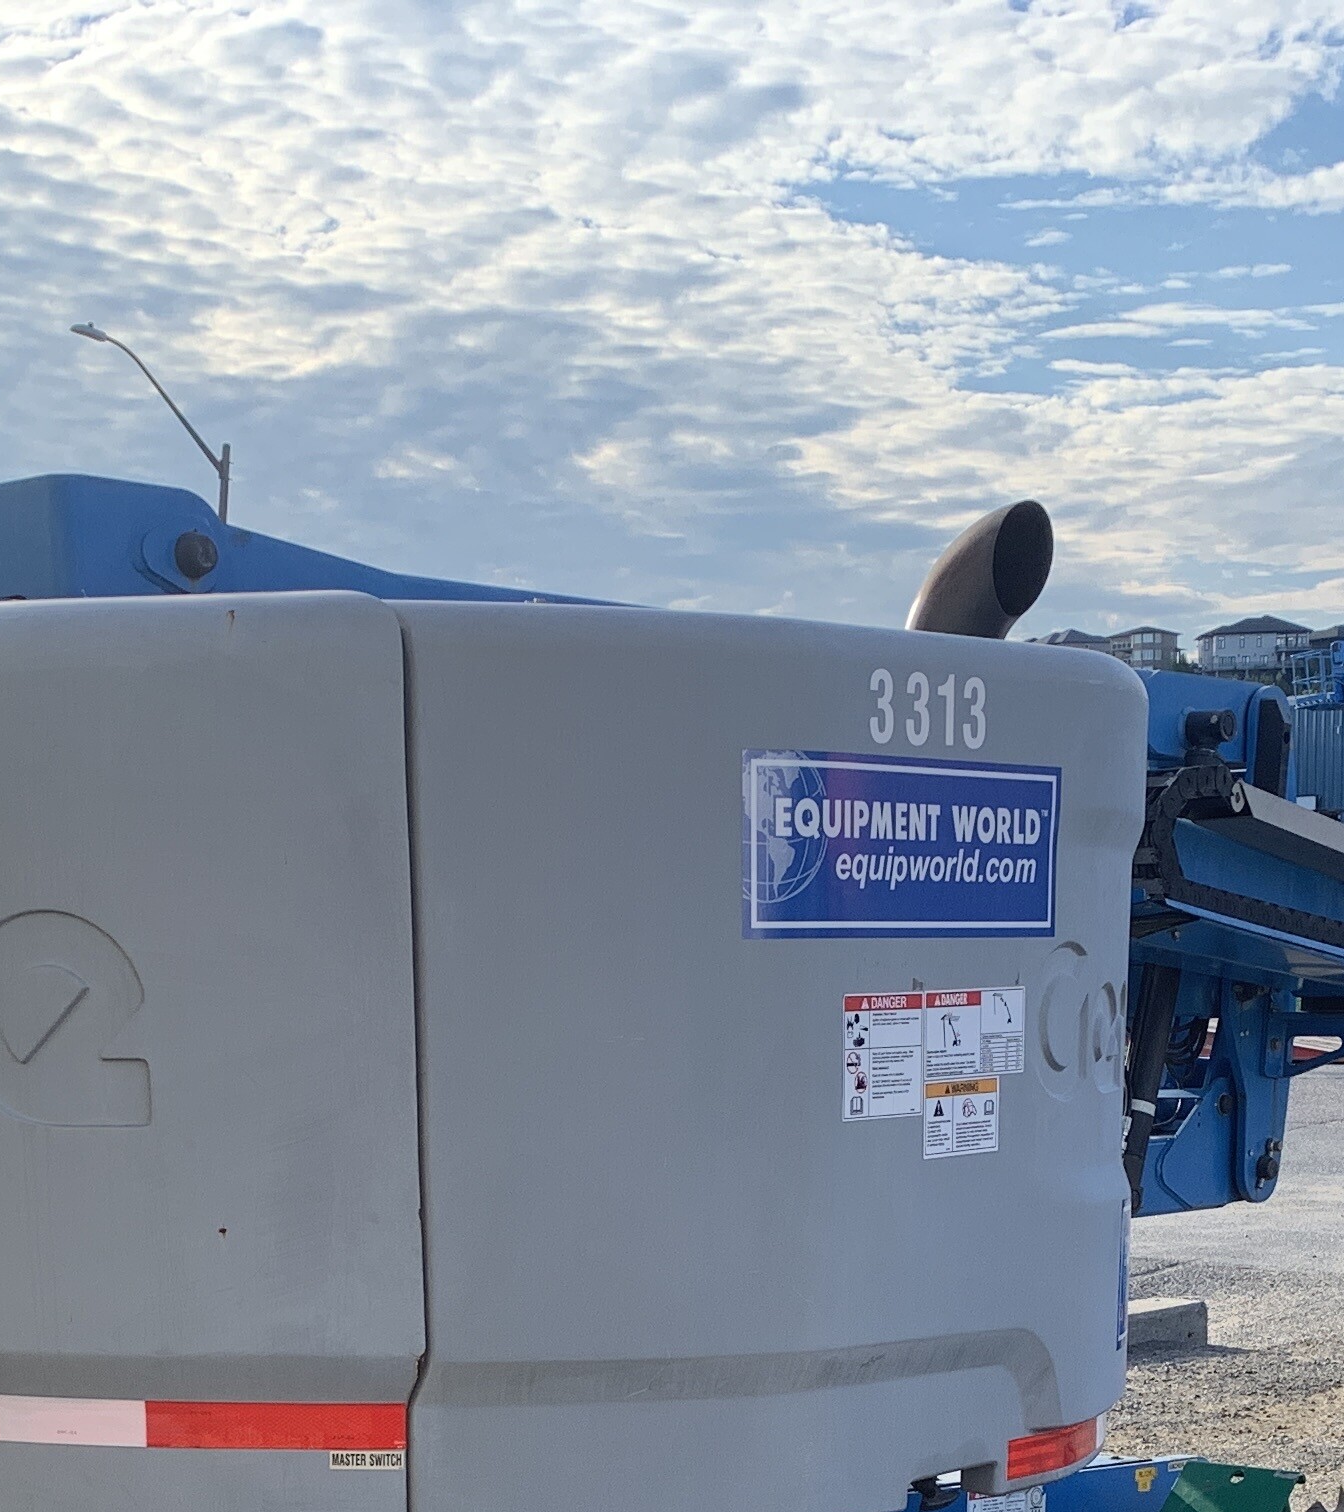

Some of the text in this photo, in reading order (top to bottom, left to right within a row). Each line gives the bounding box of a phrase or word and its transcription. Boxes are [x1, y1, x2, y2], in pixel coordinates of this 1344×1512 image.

[869, 668, 987, 750] 3313
[774, 797, 1042, 845] EQUIPMENT WORLD
[835, 846, 1037, 890] equipworld.com
[871, 996, 907, 1009] DANGER
[941, 993, 968, 1006] DANGER
[331, 1453, 402, 1467] MASTER SWITCH
